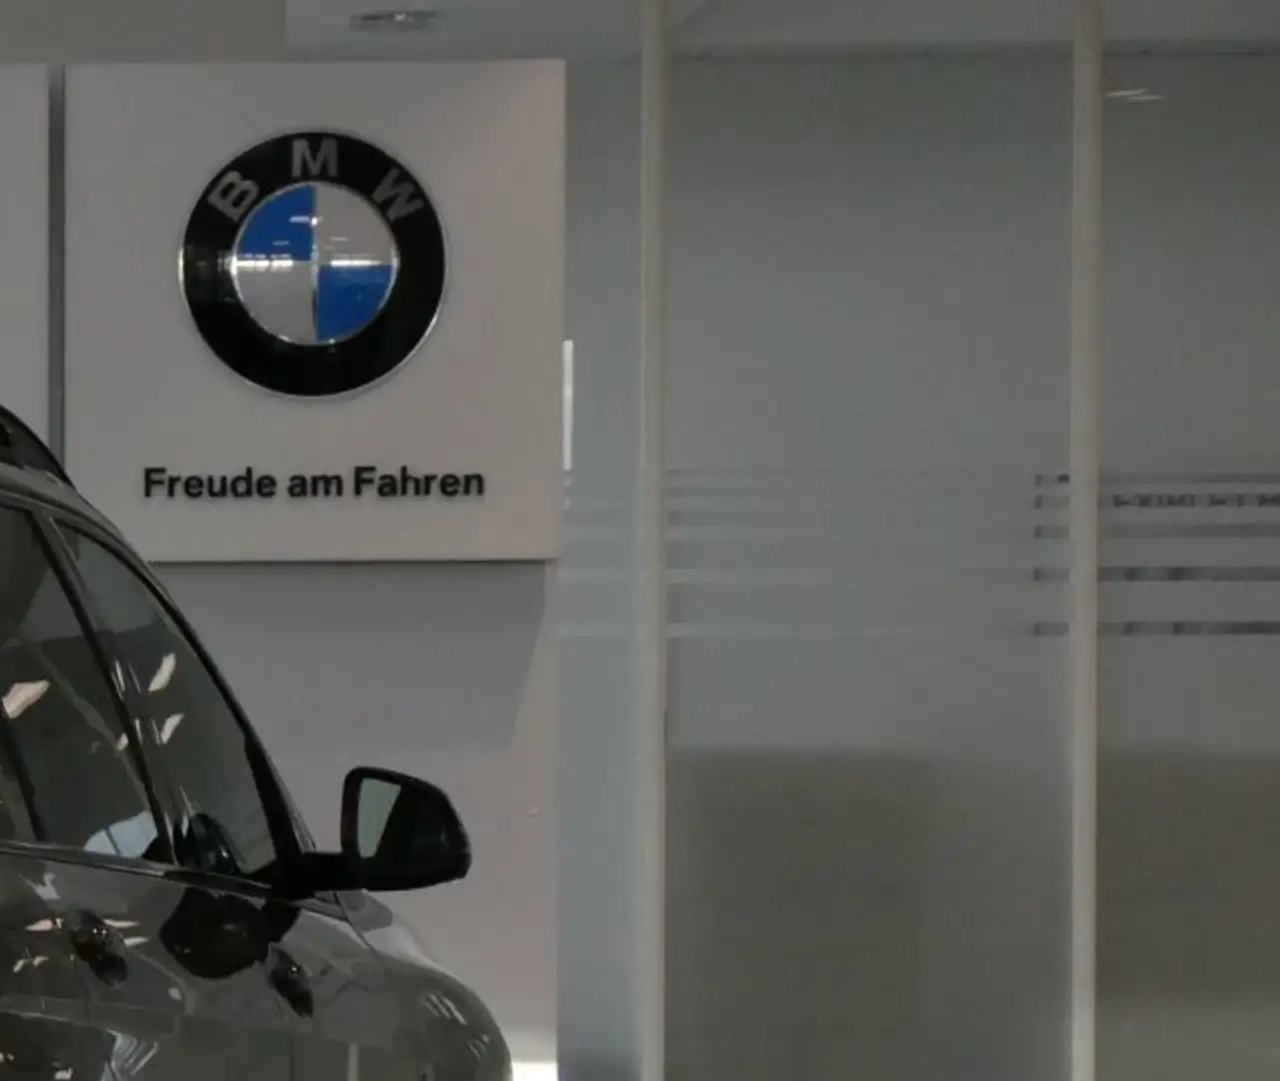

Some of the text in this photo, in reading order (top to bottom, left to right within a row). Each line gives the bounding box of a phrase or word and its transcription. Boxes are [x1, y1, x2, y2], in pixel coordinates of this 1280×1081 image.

[208, 138, 424, 222] BMW
[144, 464, 486, 498] Freude am Fahren
